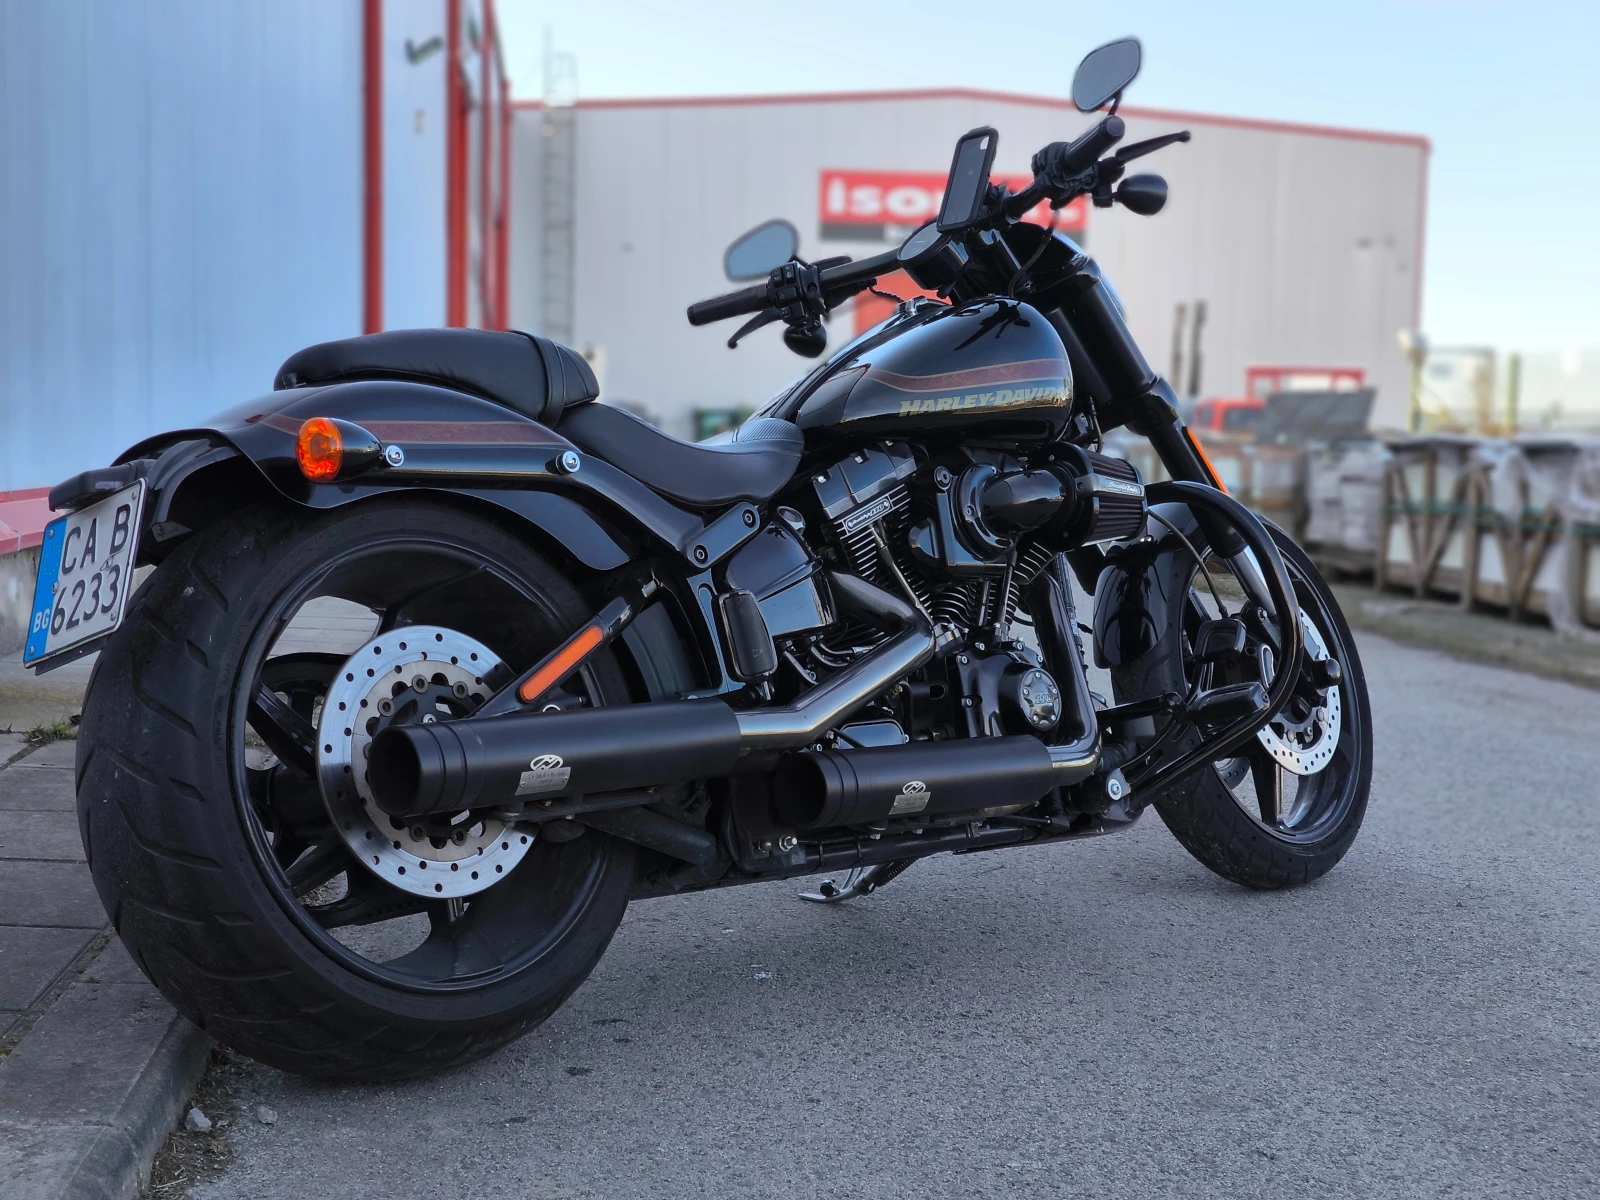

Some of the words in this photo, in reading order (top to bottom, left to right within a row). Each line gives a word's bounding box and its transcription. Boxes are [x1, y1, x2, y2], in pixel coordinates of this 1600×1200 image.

[898, 386, 1068, 417] HARLEY-DAVID
[61, 517, 98, 576] CA
[109, 503, 131, 555] B
[33, 608, 50, 633] BG
[50, 564, 122, 636] 6233
